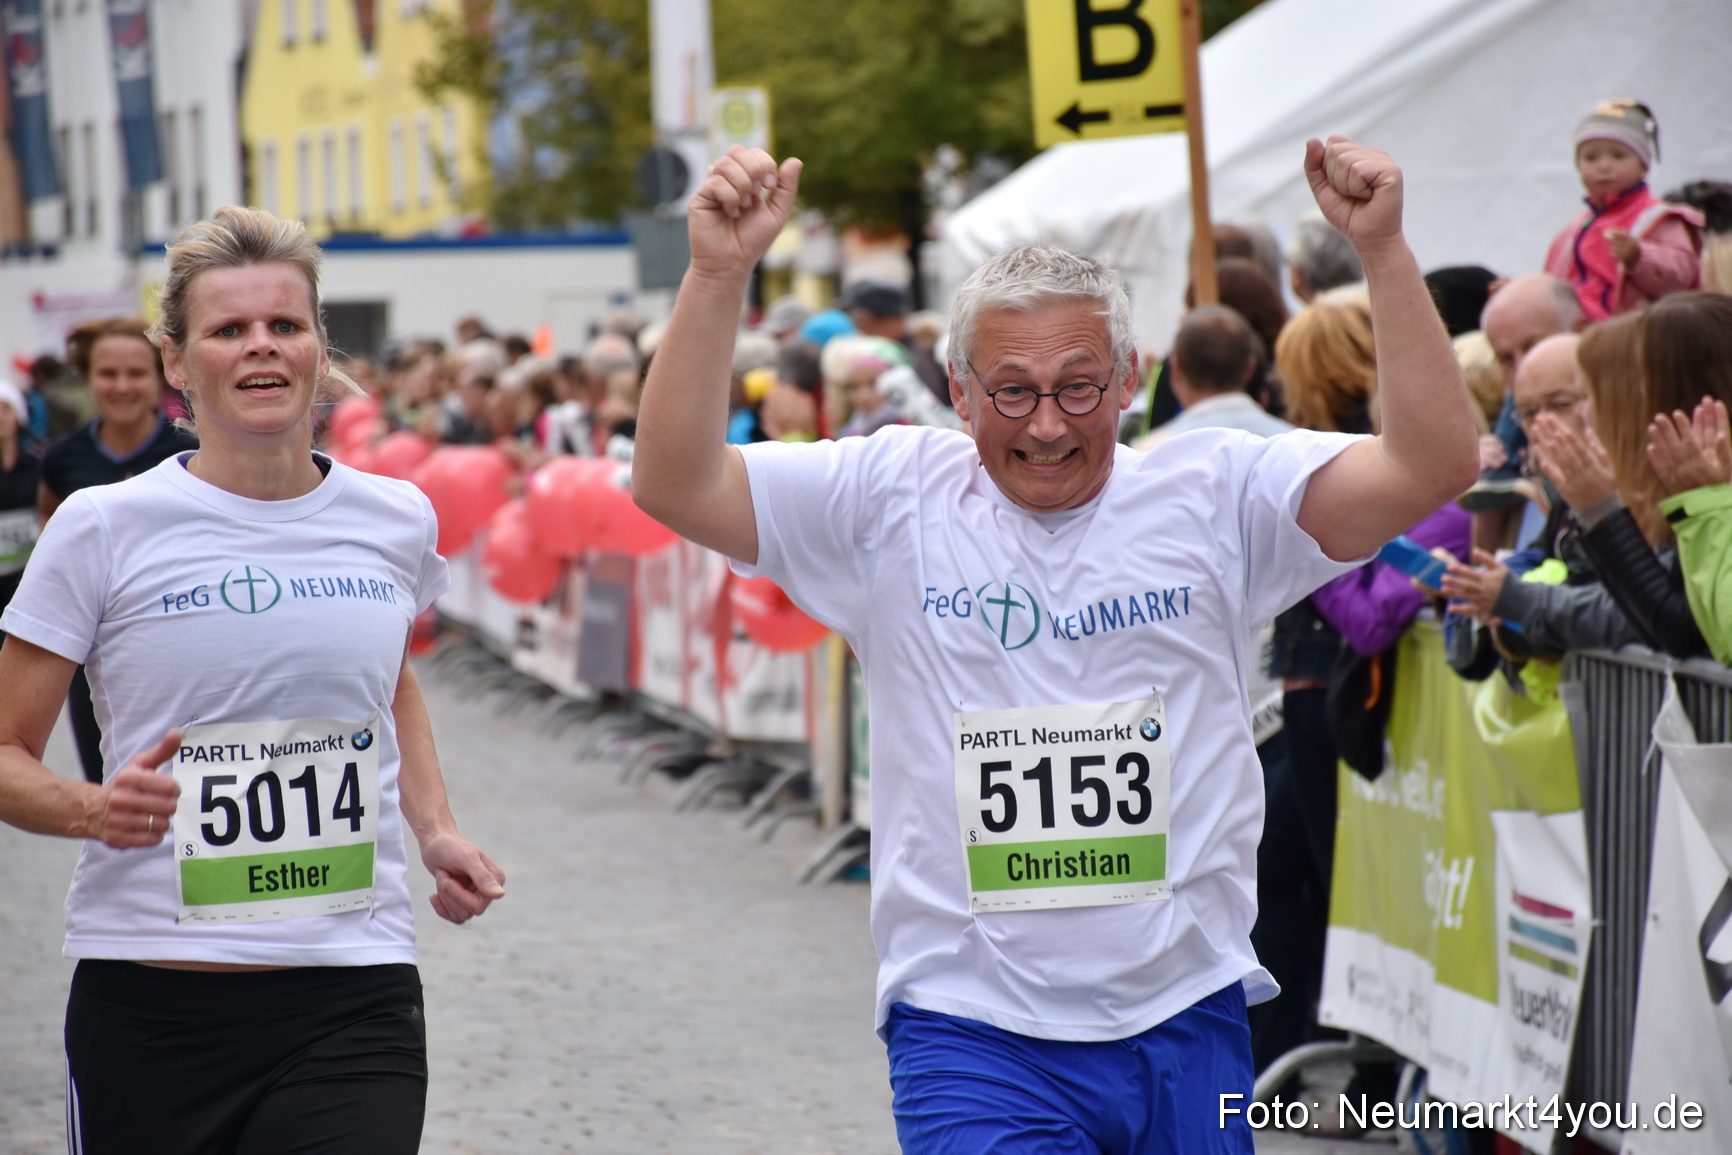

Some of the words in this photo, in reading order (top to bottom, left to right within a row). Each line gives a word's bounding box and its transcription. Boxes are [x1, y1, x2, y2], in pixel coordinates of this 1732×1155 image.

[1075, 0, 1156, 83] B
[162, 584, 210, 614] FeG
[290, 577, 397, 605] NEUMARKT
[923, 586, 972, 618] FeG
[180, 744, 254, 763] PARTL
[260, 734, 344, 760] Neumarkt
[960, 729, 1026, 750] PARTL
[1032, 724, 1132, 745] Neumarkt
[200, 762, 365, 847] 5014
[980, 752, 1152, 833] 5153
[185, 843, 194, 857] S
[969, 830, 977, 843] S
[249, 862, 330, 893] Esther
[1007, 849, 1131, 881] Christian
